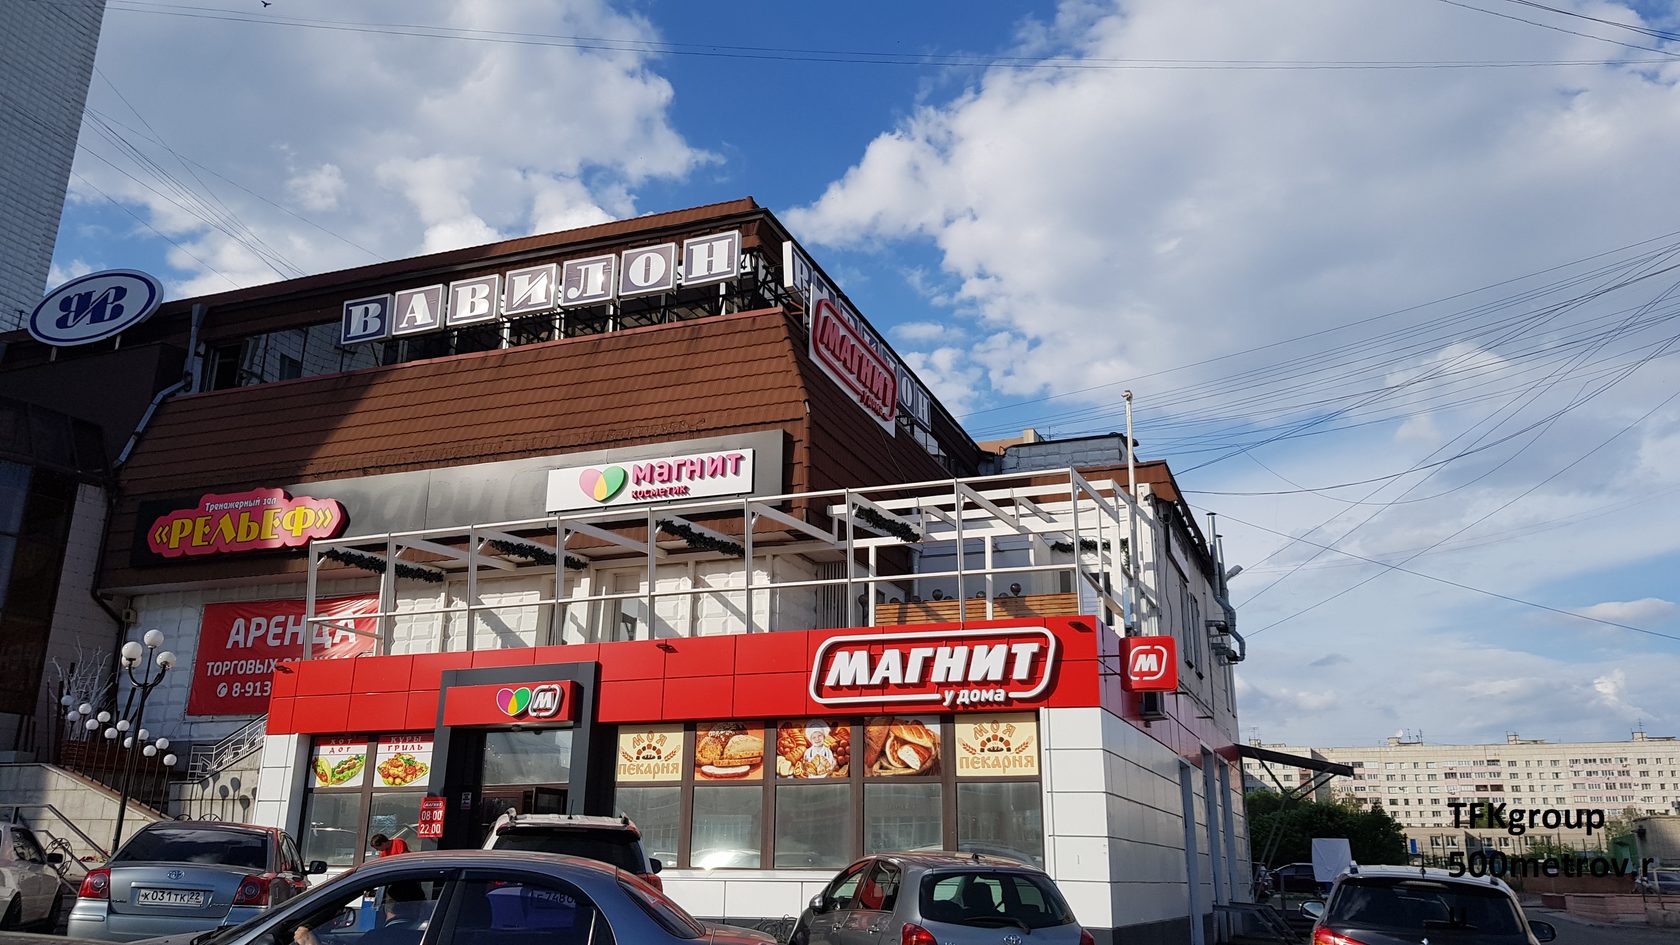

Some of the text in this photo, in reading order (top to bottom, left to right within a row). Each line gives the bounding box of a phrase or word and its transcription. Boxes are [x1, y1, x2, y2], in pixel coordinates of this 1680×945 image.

[346, 238, 733, 337] ВАВИЛОН
[819, 315, 894, 407] МАГНИТ
[205, 496, 277, 513] Тренажерный зал
[226, 612, 357, 649] АРЕНДА
[206, 659, 277, 676] ТОРГОВЫХ
[825, 643, 1040, 687] МАГНИТ
[943, 688, 1006, 706] у дома
[632, 730, 667, 749] МОЯ
[973, 720, 1016, 740] МОЯ
[390, 736, 422, 744] КУРЫ
[189, 892, 200, 900] 22
